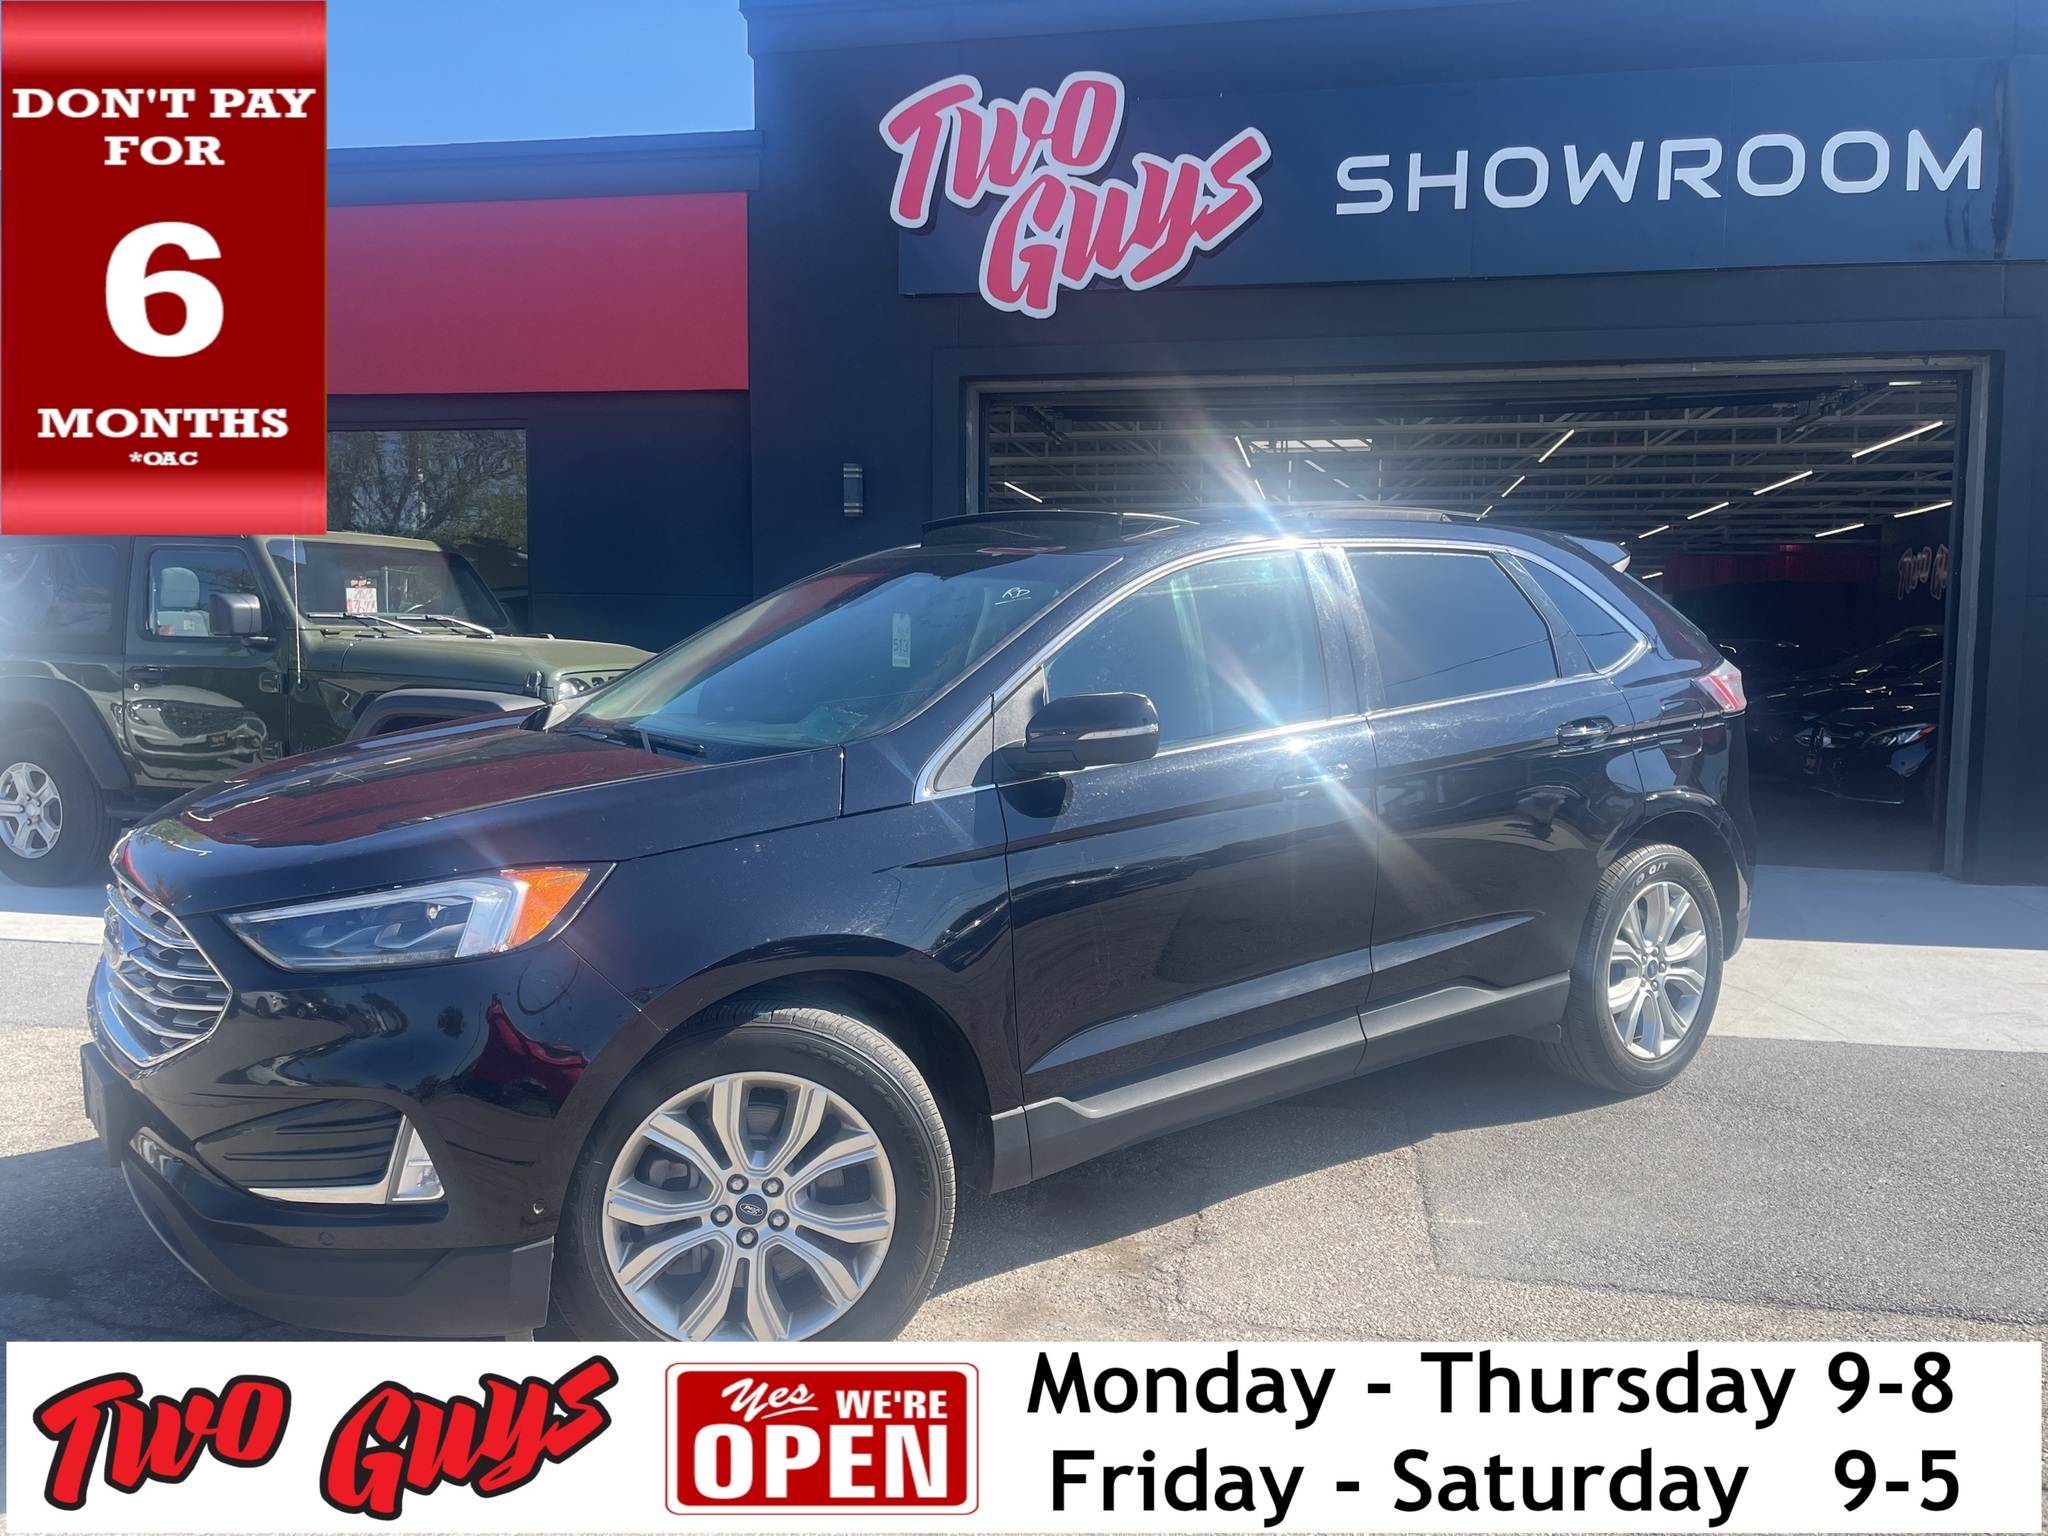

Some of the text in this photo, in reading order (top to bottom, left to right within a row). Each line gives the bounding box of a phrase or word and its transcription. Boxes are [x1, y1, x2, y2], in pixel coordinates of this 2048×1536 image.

[879, 71, 1126, 229] Two
[979, 127, 1273, 320] Guys
[1336, 127, 1983, 215] SHOWROOM
